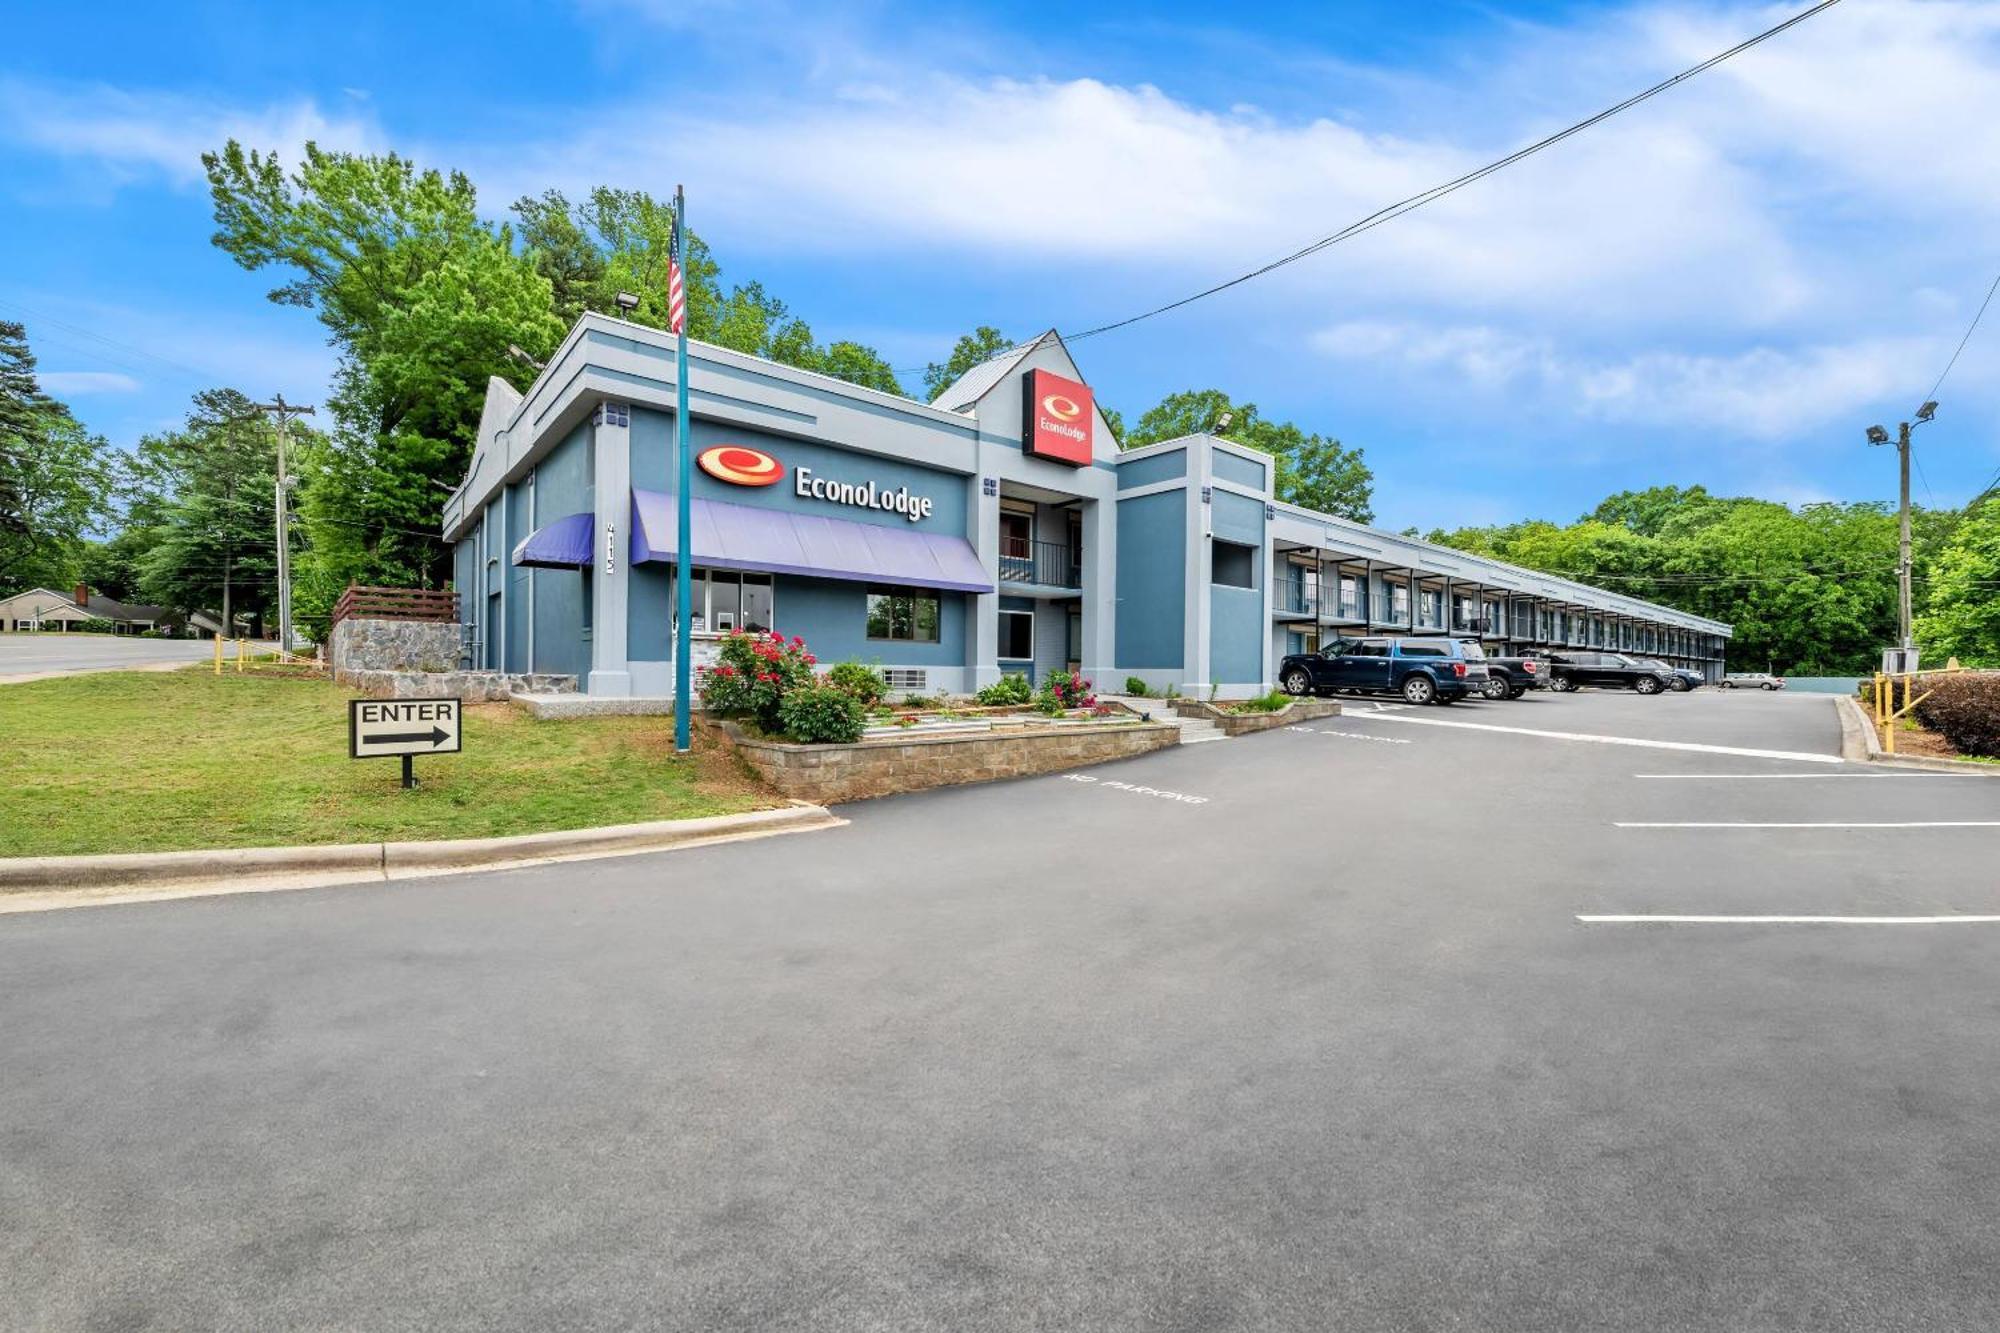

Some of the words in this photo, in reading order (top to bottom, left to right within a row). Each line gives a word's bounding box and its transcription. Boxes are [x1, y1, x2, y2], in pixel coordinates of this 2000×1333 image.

[1040, 416, 1086, 442] EconoLodge
[795, 466, 932, 522] EconoLodge
[607, 523, 615, 572] 4115
[362, 703, 452, 723] ENTER
